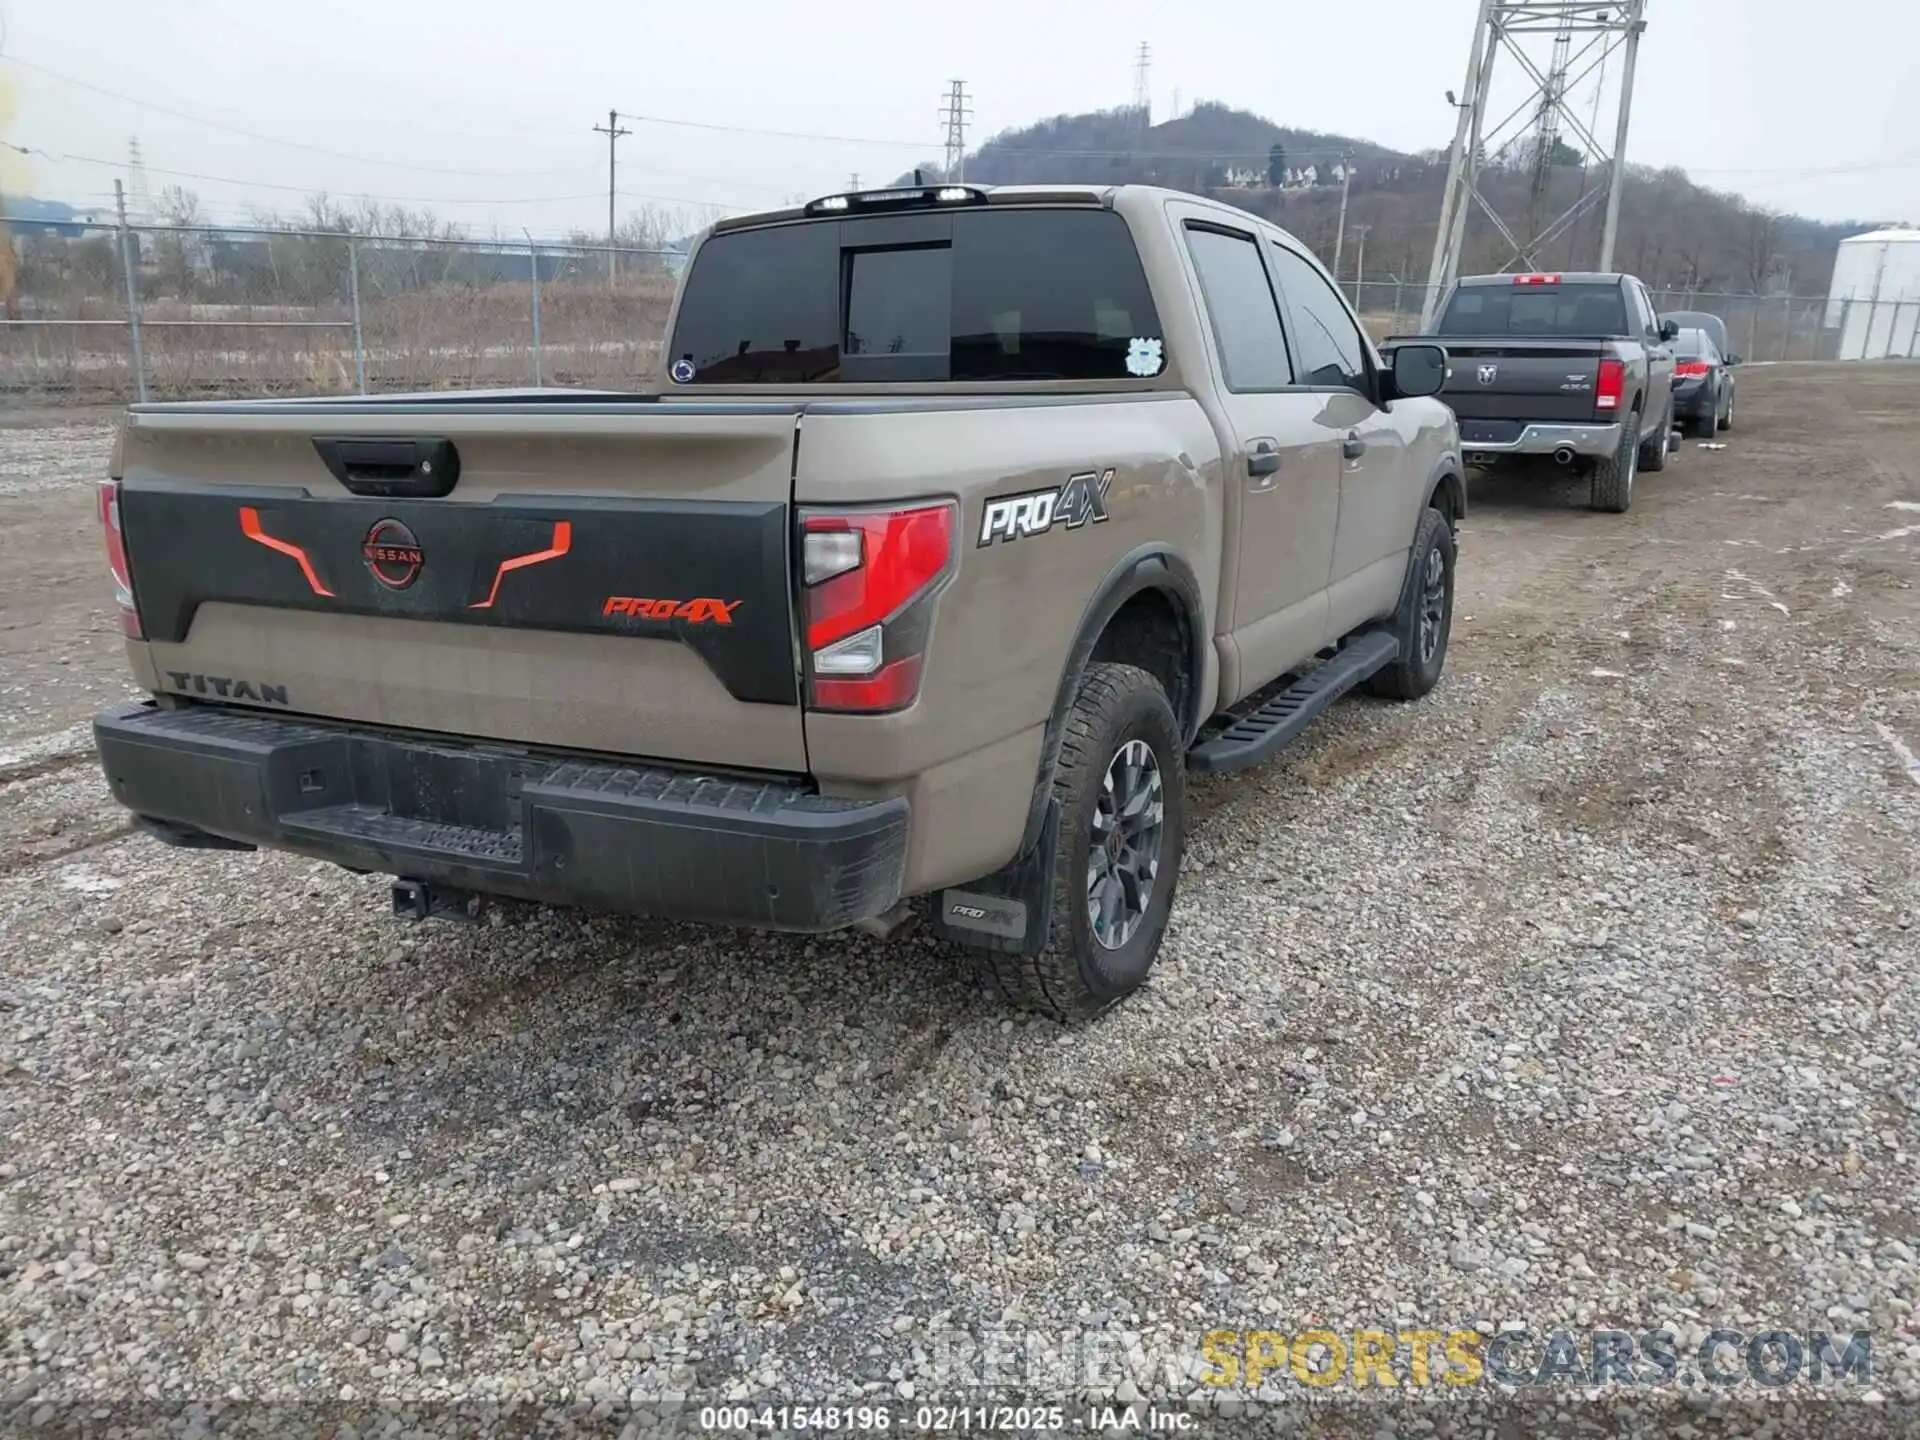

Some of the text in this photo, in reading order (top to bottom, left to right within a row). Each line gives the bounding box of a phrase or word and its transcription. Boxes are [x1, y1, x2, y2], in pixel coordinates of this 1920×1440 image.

[364, 546, 422, 564] NISSAN
[602, 596, 744, 624] PRO4X
[165, 670, 288, 705] TITAN
